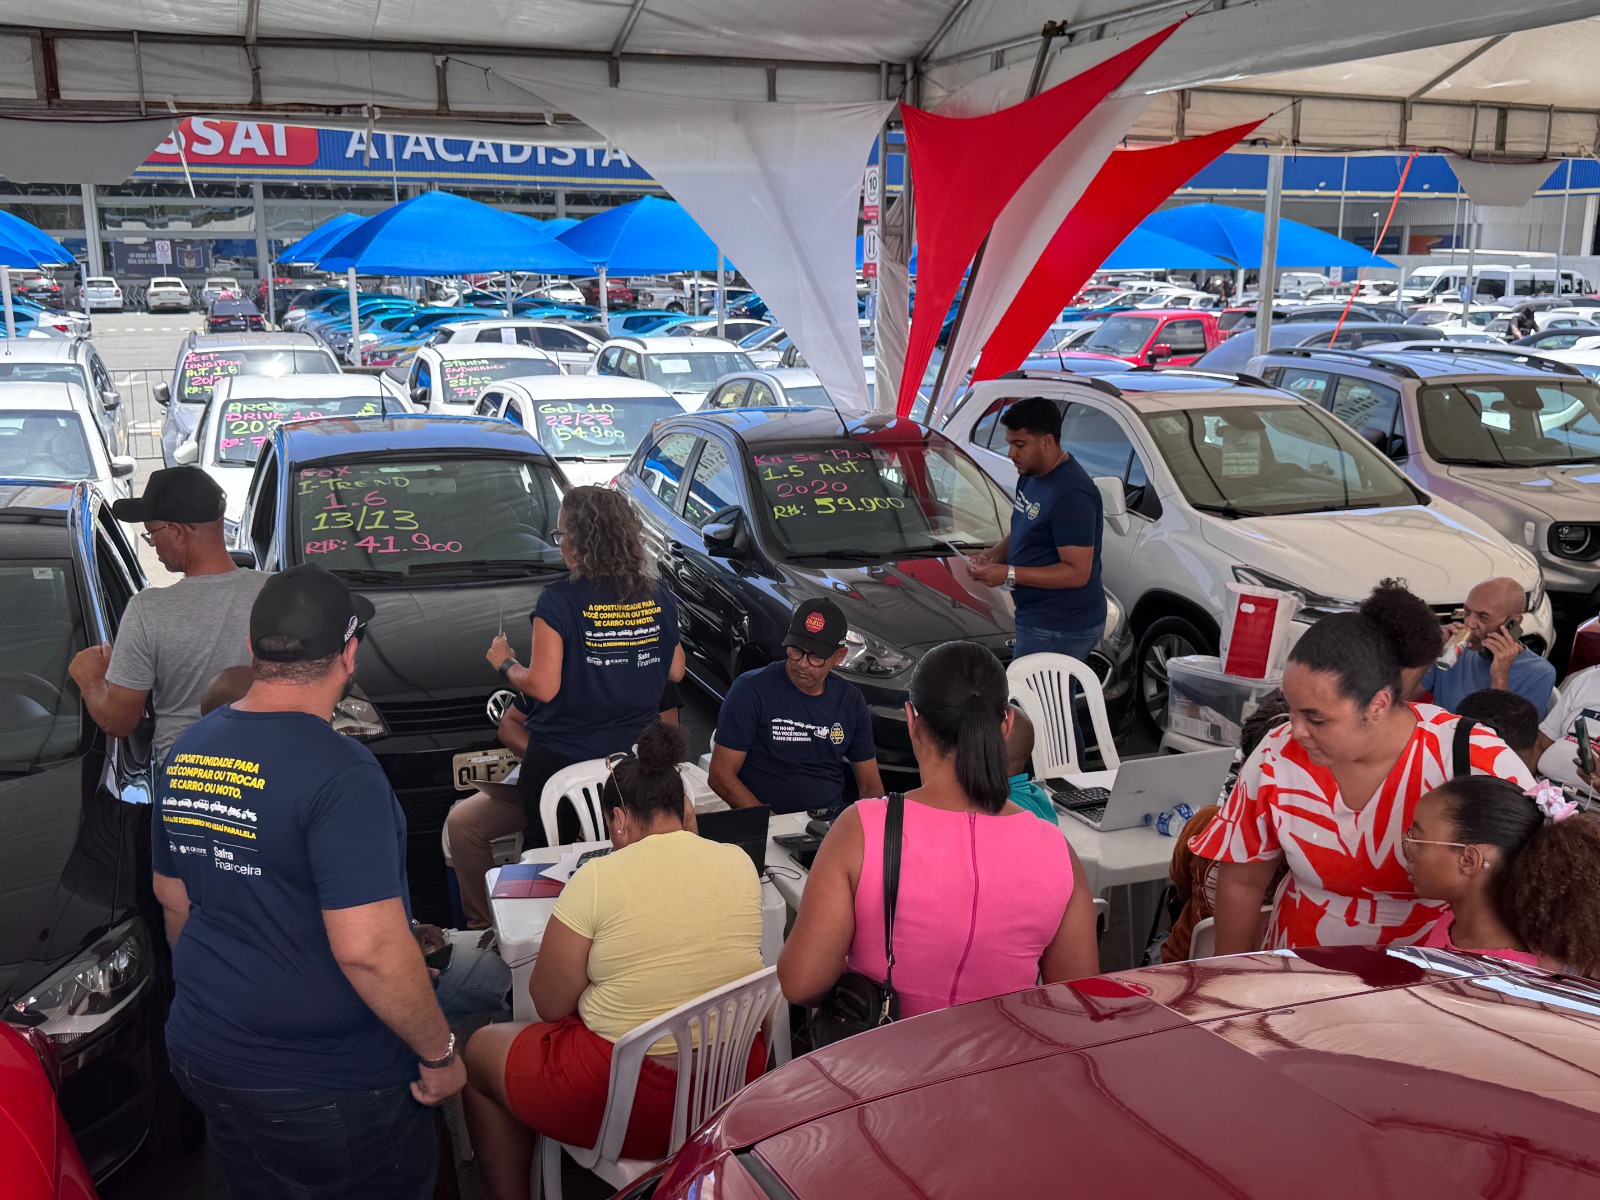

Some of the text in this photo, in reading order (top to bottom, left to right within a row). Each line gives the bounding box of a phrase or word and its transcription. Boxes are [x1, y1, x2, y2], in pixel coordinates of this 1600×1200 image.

[345, 131, 632, 168] ATACADISTA
[869, 176, 877, 190] 10
[449, 376, 492, 387] 22/22
[228, 402, 287, 412] ARGO
[586, 403, 615, 413] 1.0
[226, 411, 285, 421] DRIVE
[545, 412, 613, 426] 22/23
[300, 466, 352, 480] FOX
[763, 465, 804, 481] 1.5
[777, 480, 848, 498] 2020
[323, 490, 387, 510] 1.6
[312, 506, 419, 531] 13/13
[179, 754, 235, 768] OPORTUNIDADE
[233, 759, 260, 774] PARA
[178, 766, 213, 779] COMPRAR
[214, 770, 226, 780] OU
[226, 771, 265, 789] TROCAR
[169, 779, 242, 799] DE CARRO OU MOTO.
[224, 826, 257, 840] PARALELA
